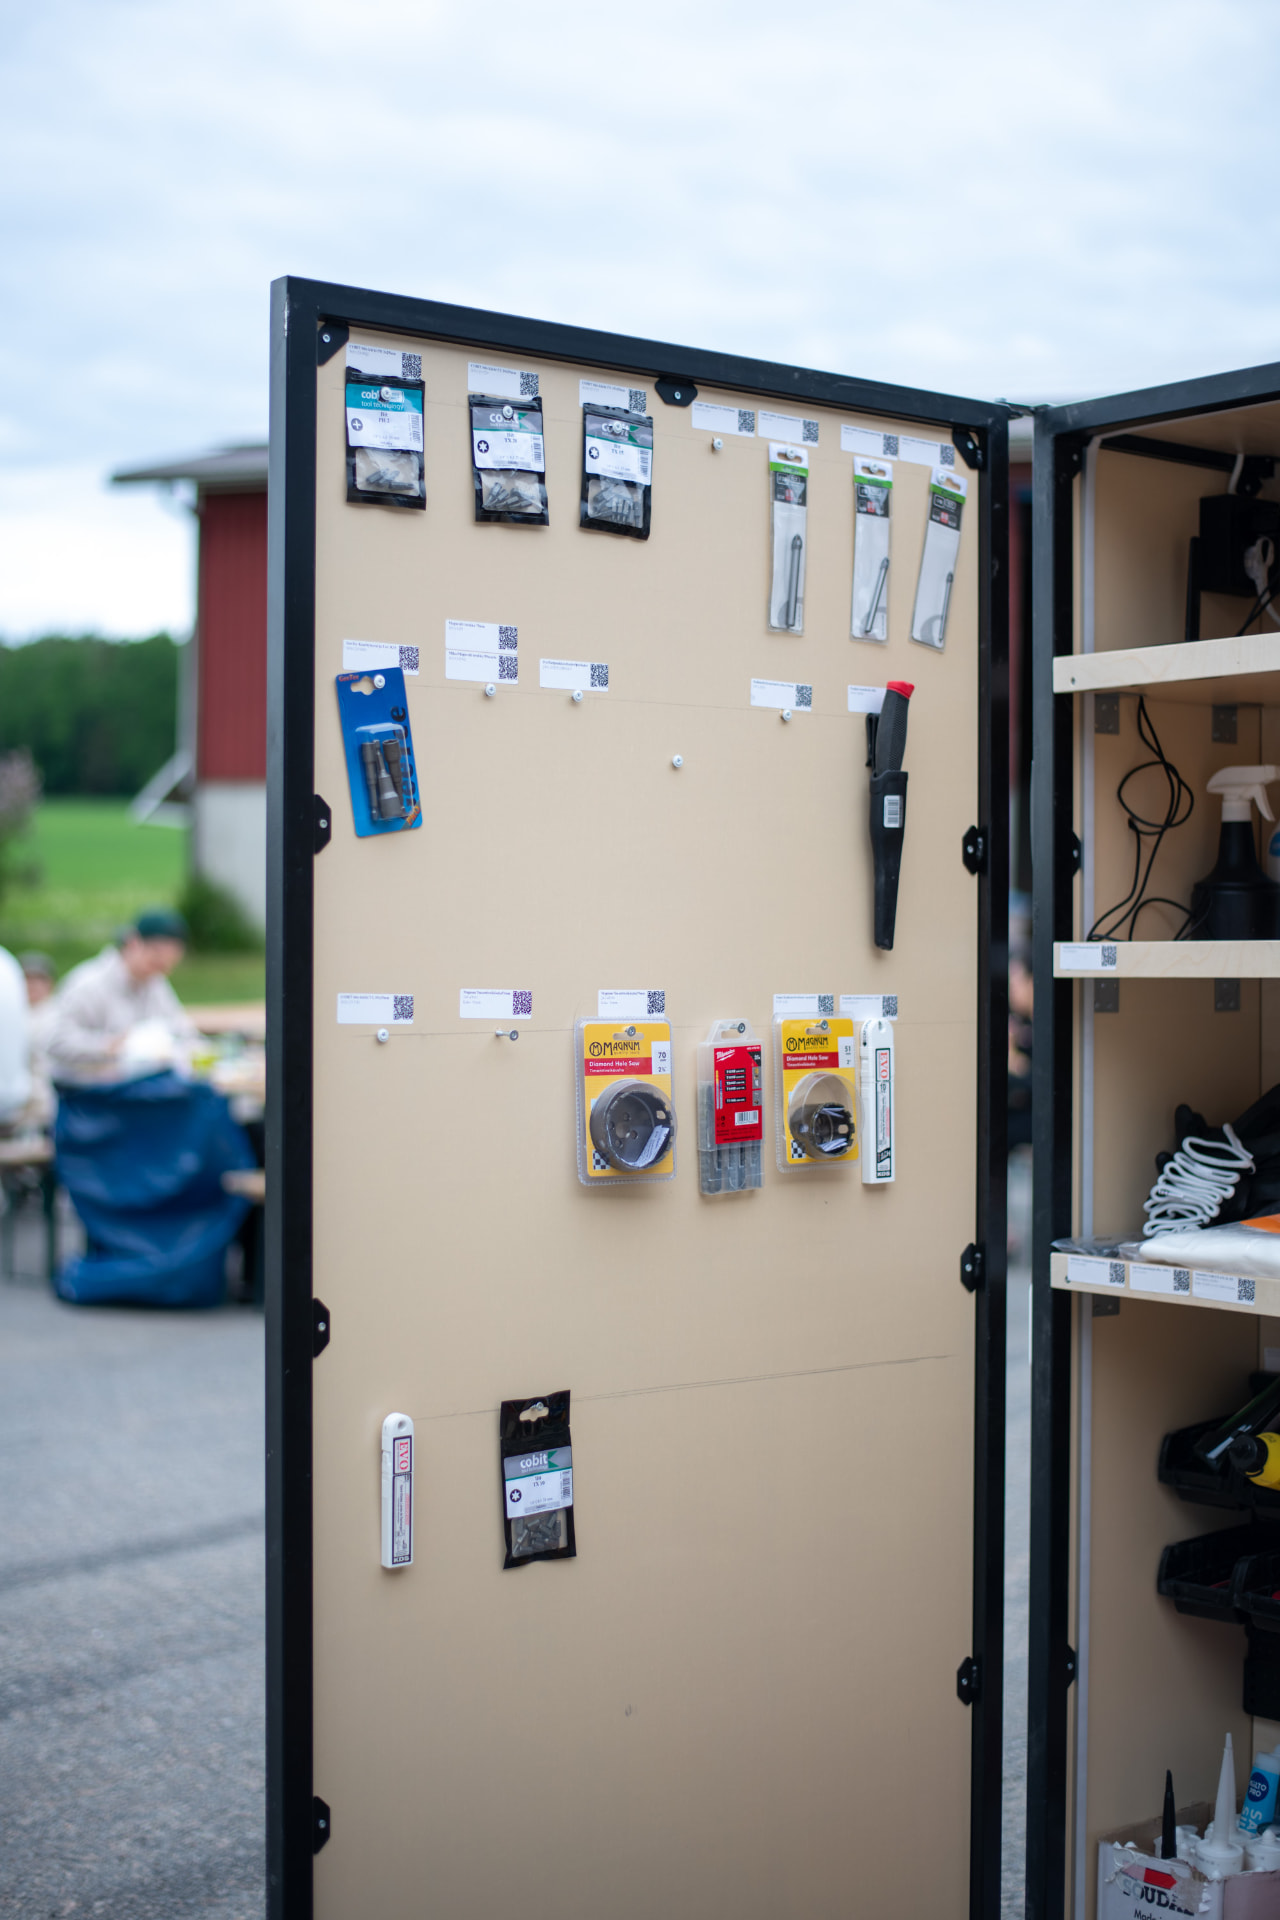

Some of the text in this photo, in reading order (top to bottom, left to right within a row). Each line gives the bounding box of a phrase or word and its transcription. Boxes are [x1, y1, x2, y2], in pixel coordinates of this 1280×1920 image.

[406, 805, 421, 826] PRO
[603, 1041, 641, 1056] MAGNUM
[798, 1036, 829, 1051] MAGNUM
[400, 1441, 408, 1470] EVO
[520, 1453, 548, 1468] cobit
[1123, 1878, 1195, 1917] SOUD
